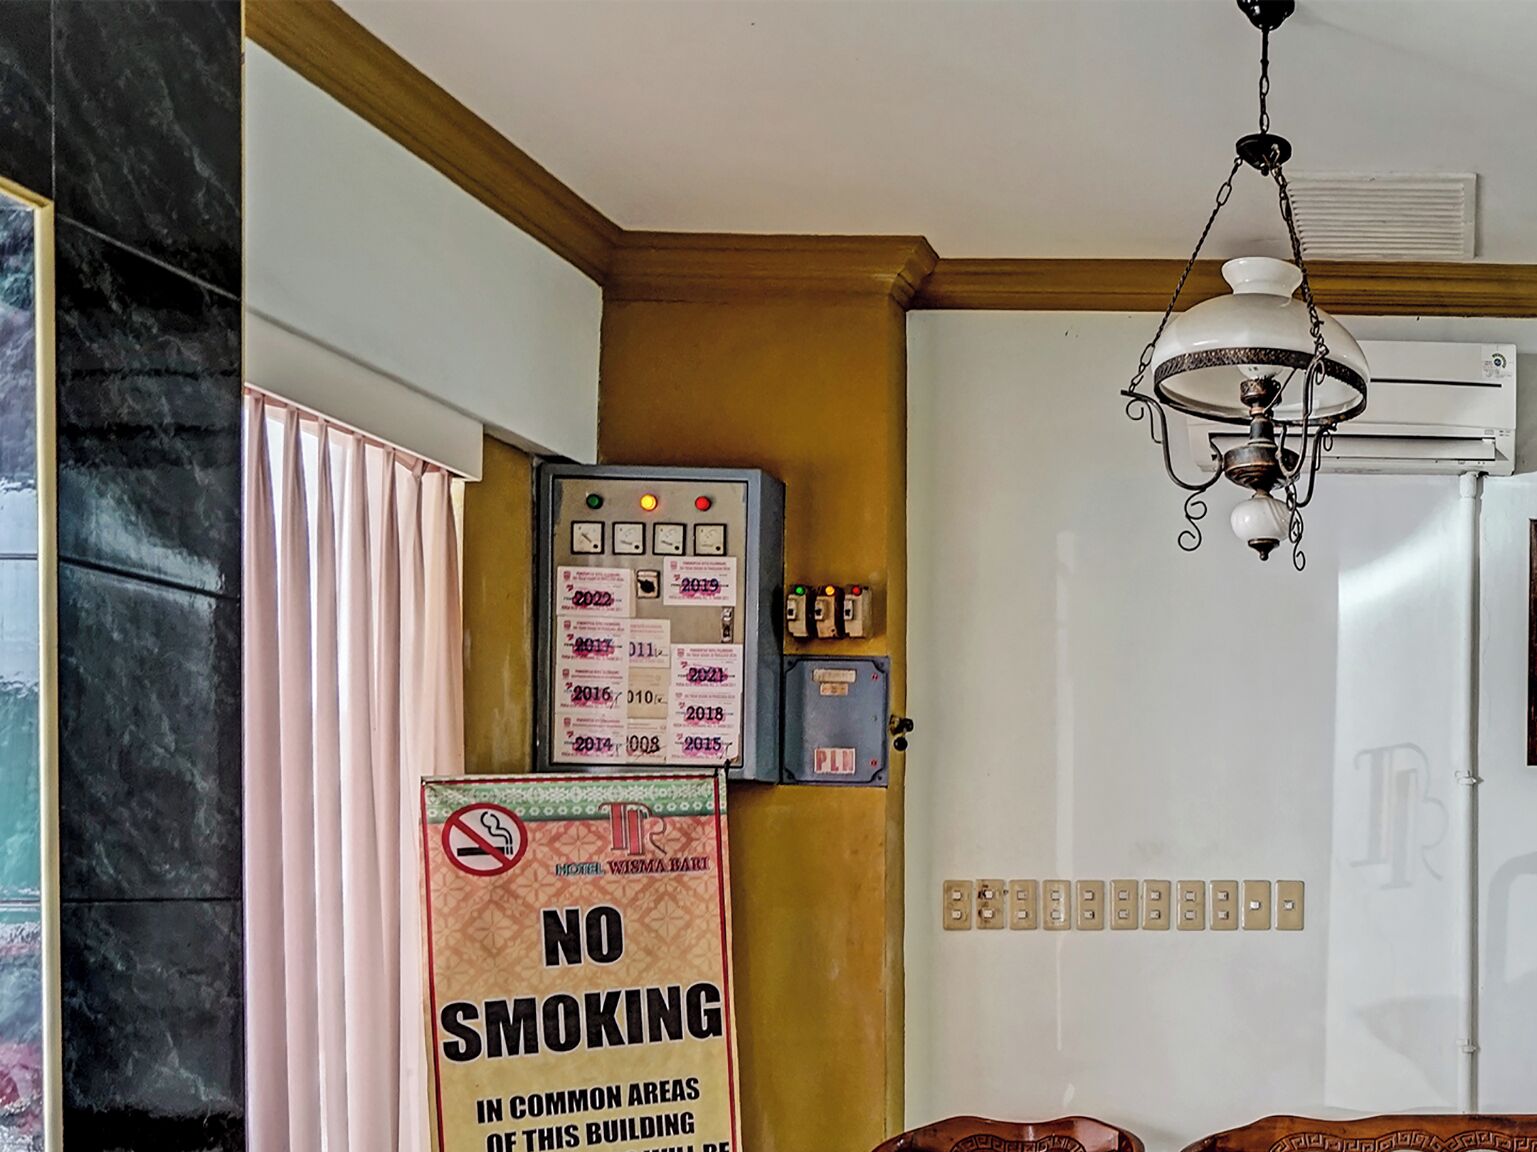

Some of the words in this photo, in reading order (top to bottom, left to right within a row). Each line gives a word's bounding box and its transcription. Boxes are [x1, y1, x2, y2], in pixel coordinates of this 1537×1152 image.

[681, 577, 719, 593] 2019
[574, 590, 612, 607] 2022
[629, 641, 655, 657] 011
[573, 685, 611, 701] 2016
[627, 689, 653, 704] 010
[686, 705, 723, 721] 2018
[575, 736, 613, 752] 2014
[684, 736, 721, 751] 2015
[555, 862, 604, 876] HOTEL
[607, 857, 667, 875] WISMA
[669, 856, 710, 874] BARI
[542, 906, 624, 967] NO
[440, 982, 723, 1062] SMOKING
[476, 1098, 503, 1124] IN
[509, 1085, 622, 1120] COMMON
[627, 1077, 700, 1107] AREAS
[521, 1124, 580, 1152] THIS
[585, 1111, 695, 1146] BUILDING
